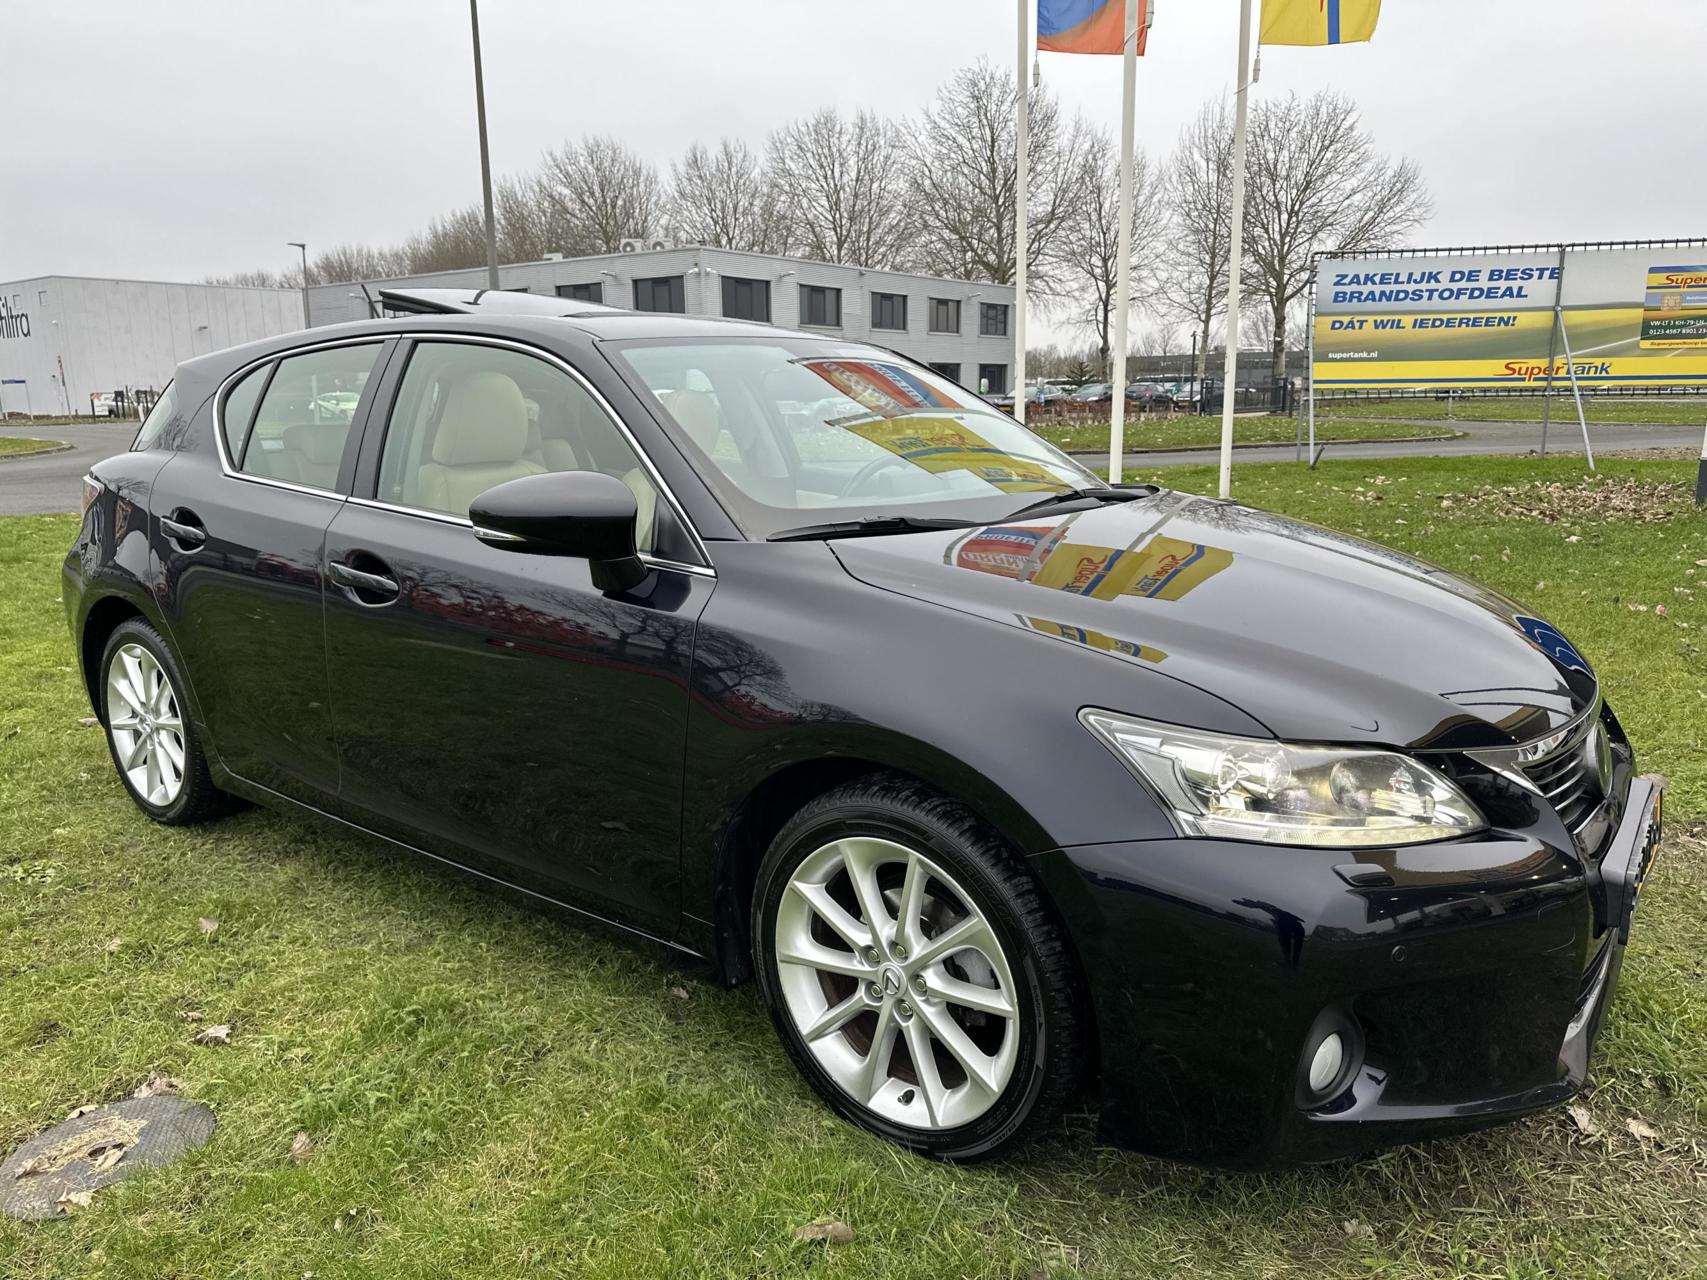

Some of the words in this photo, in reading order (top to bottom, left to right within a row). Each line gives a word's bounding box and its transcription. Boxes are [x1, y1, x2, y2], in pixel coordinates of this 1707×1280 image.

[1333, 271, 1443, 286] ZAKELIJK
[1449, 270, 1482, 282] DE
[1488, 267, 1561, 281] BESTE
[1332, 286, 1528, 303] BRANDSTOFDEAL
[1330, 317, 1368, 330] DÁT
[1373, 319, 1406, 330] WIL
[1412, 316, 1517, 329] IEDEREEN!
[1328, 351, 1378, 359] supertank.nl
[1494, 361, 1613, 382] SuperTank
